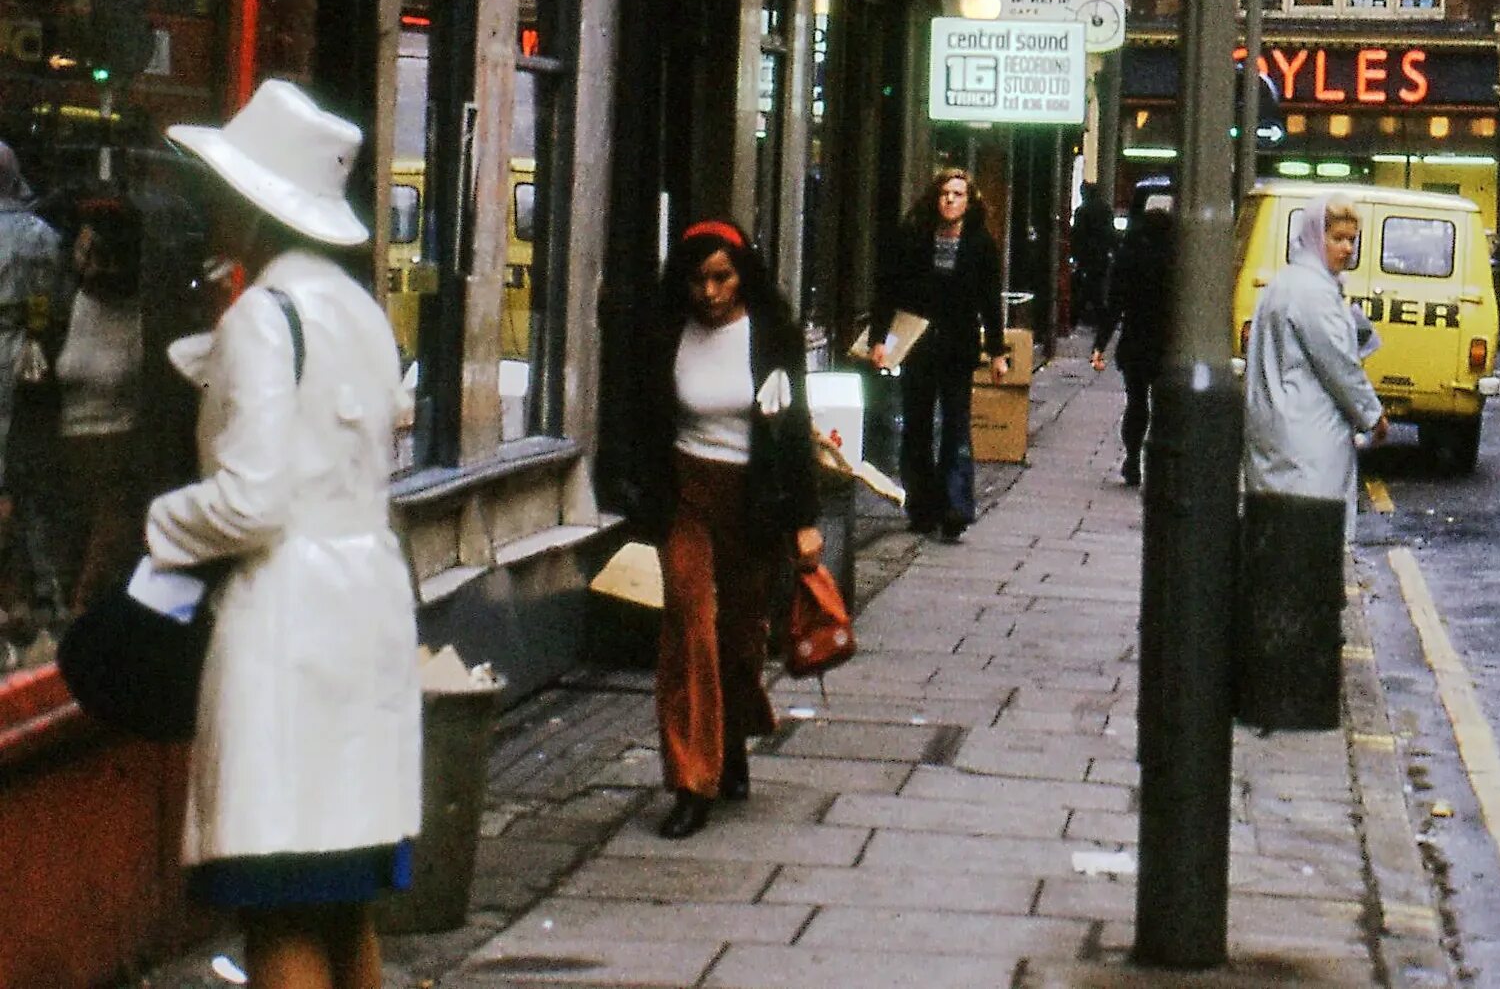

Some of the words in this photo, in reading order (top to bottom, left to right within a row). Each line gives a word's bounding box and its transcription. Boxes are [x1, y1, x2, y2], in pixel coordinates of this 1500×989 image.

[947, 28, 1011, 51] central
[1015, 29, 1069, 52] sound
[1004, 54, 1071, 75] RECORDING
[1256, 48, 1428, 103] YLES
[1004, 76, 1046, 95] STUDIO
